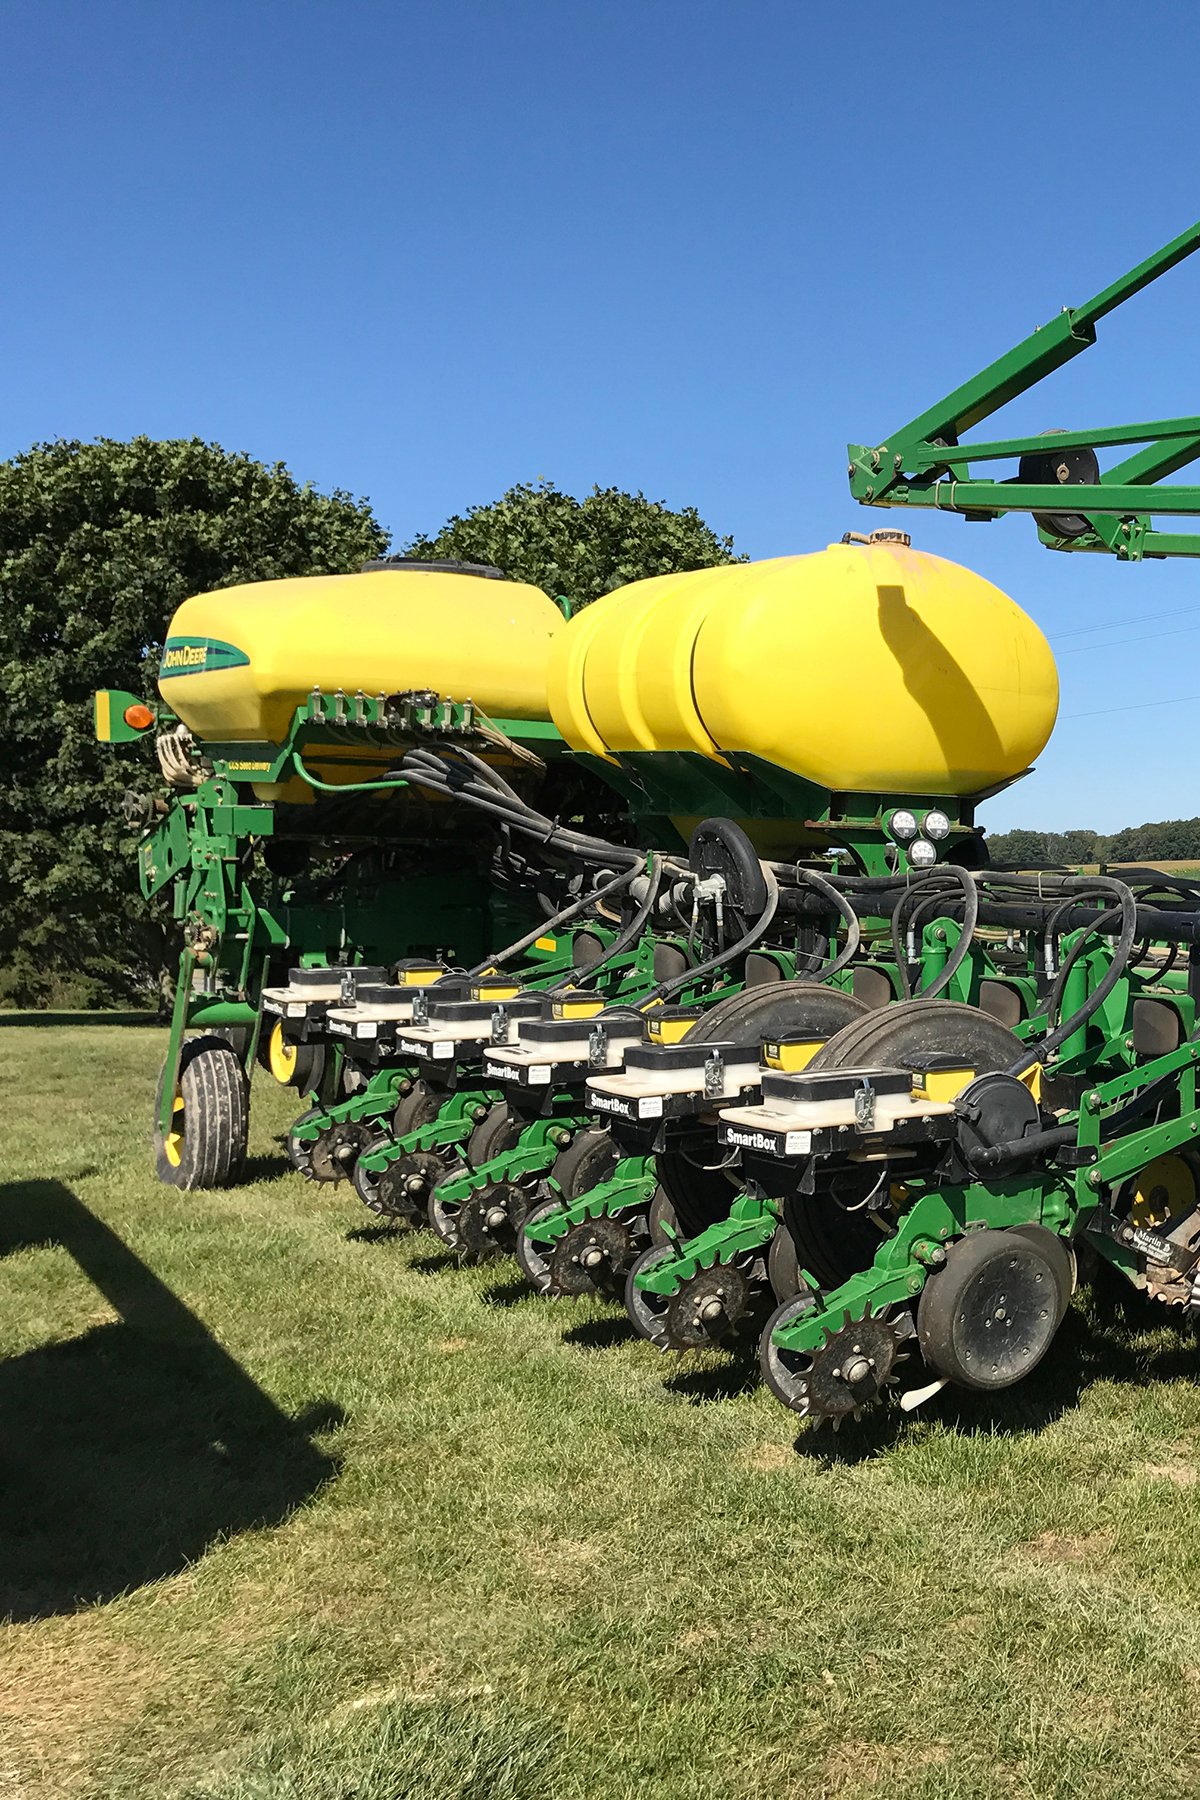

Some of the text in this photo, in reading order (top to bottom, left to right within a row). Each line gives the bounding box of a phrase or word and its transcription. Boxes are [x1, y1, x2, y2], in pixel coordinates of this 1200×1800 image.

[163, 646, 207, 668] JOHN DEERE
[401, 1039, 428, 1056] SmartBox
[487, 1062, 520, 1081] SmartBox
[591, 1093, 629, 1114] SmartBox
[727, 1128, 776, 1151] SmartBox
[1138, 1230, 1162, 1248] Martin
